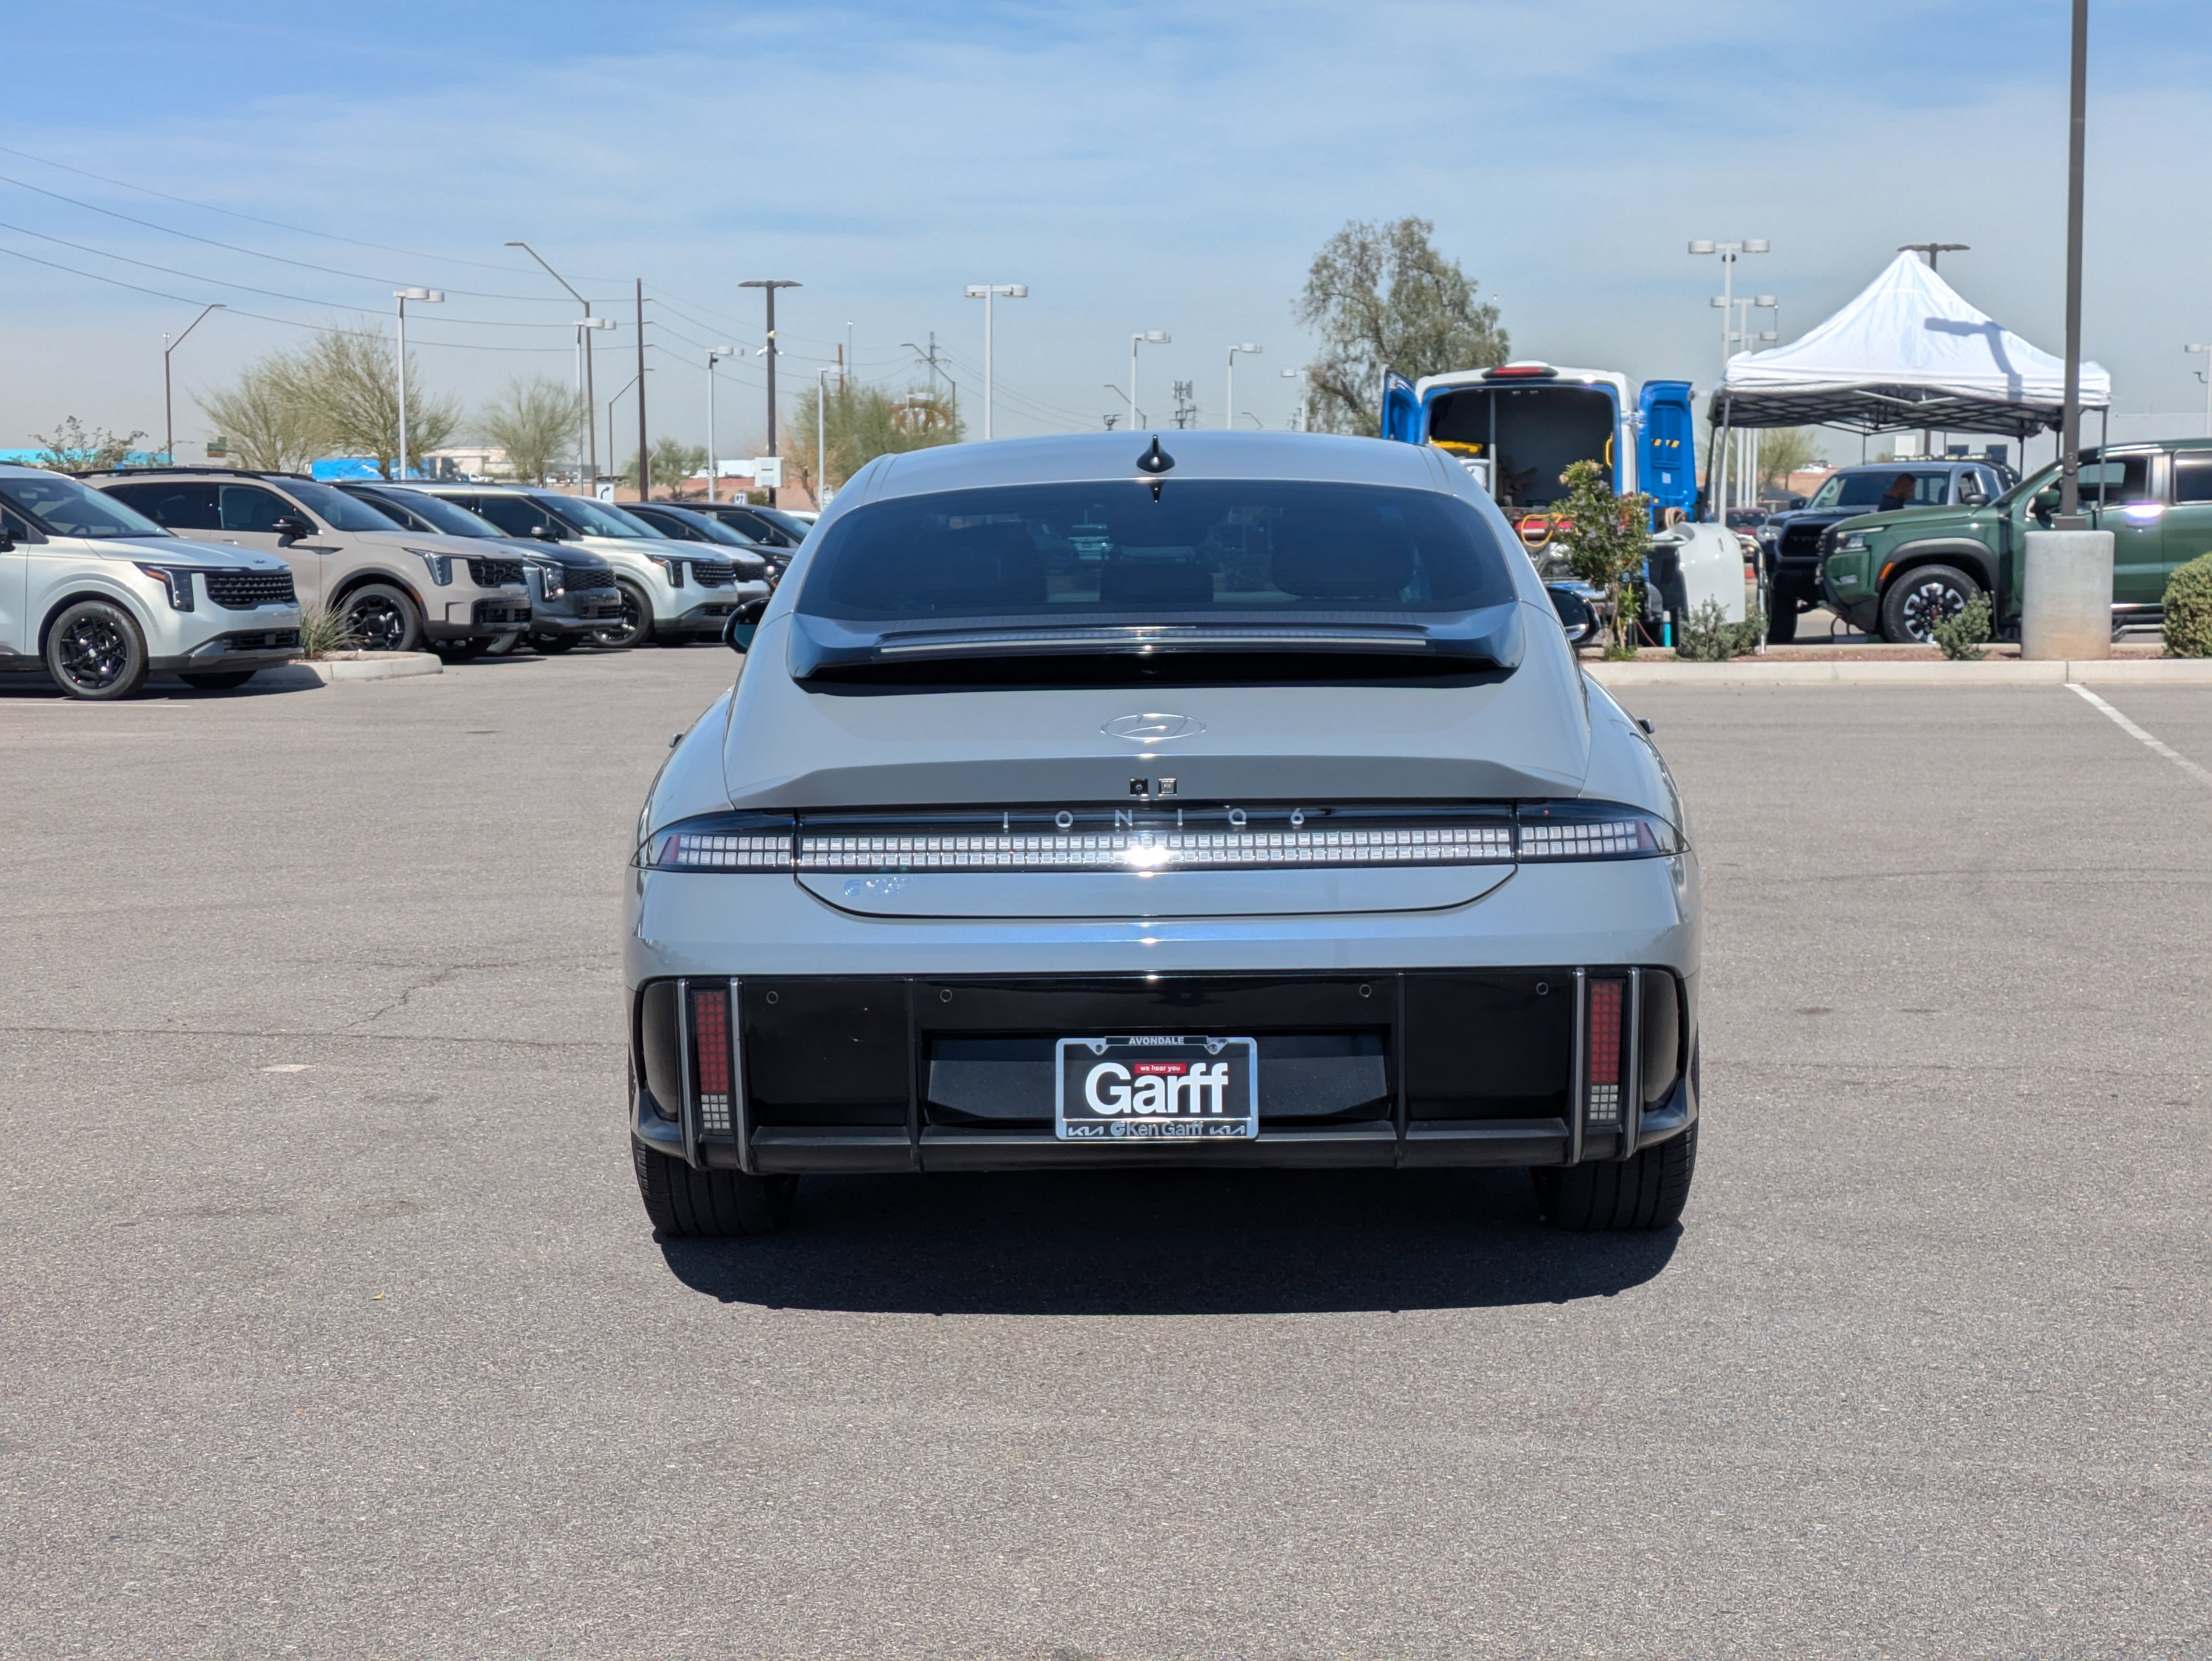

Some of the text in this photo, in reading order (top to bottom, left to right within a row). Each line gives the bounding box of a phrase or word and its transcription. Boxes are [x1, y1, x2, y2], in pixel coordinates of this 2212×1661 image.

[1004, 808, 1305, 829] IONIQ 6
[1085, 1062, 1228, 1115] Garff
[1161, 1121, 1204, 1136] Garff
